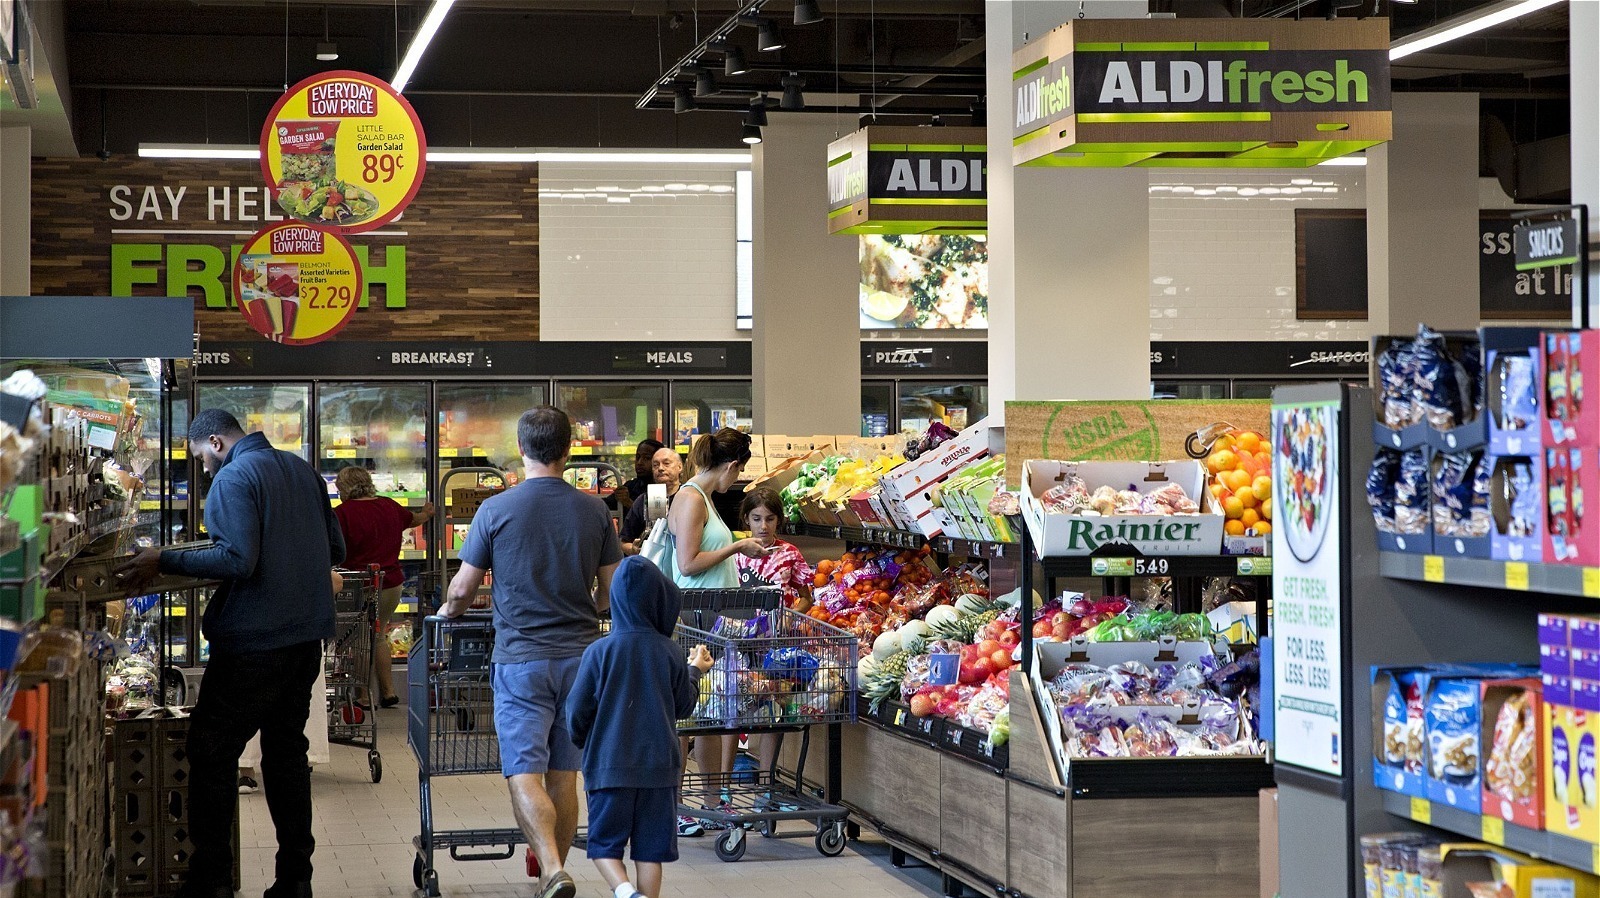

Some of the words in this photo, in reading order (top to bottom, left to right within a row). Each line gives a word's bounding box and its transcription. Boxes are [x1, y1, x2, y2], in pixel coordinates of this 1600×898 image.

[312, 82, 374, 101] EVERYDAY
[1099, 59, 1369, 104] ALDIfresh
[1016, 66, 1071, 128] ALDIfresh
[312, 100, 340, 115] LOW
[340, 100, 374, 115] PRICE
[280, 134, 304, 145] GARDEN
[304, 131, 325, 142] SALAD
[357, 125, 383, 133] LITTLE
[357, 142, 383, 151] Garden
[383, 142, 403, 151] Salad
[362, 153, 404, 184] 89¢
[886, 158, 987, 192] ALDI
[109, 185, 187, 221] SAY
[273, 228, 322, 242] EVERYDAY
[273, 241, 295, 253] LOW
[296, 241, 322, 253] PRICE
[111, 245, 407, 308] FRH
[300, 276, 314, 284] Fruit
[314, 276, 327, 284] Bars
[1515, 266, 1546, 295] at
[301, 285, 351, 309] $2.29
[391, 352, 474, 364] BREAKFAST
[646, 351, 693, 364] MEALS
[875, 351, 918, 364] PIZZA
[82, 411, 112, 422] CARROTS
[1063, 410, 1128, 450] USDA
[1067, 518, 1201, 551] Rainier
[1283, 576, 1298, 598] GET
[1287, 636, 1303, 659] FOR
